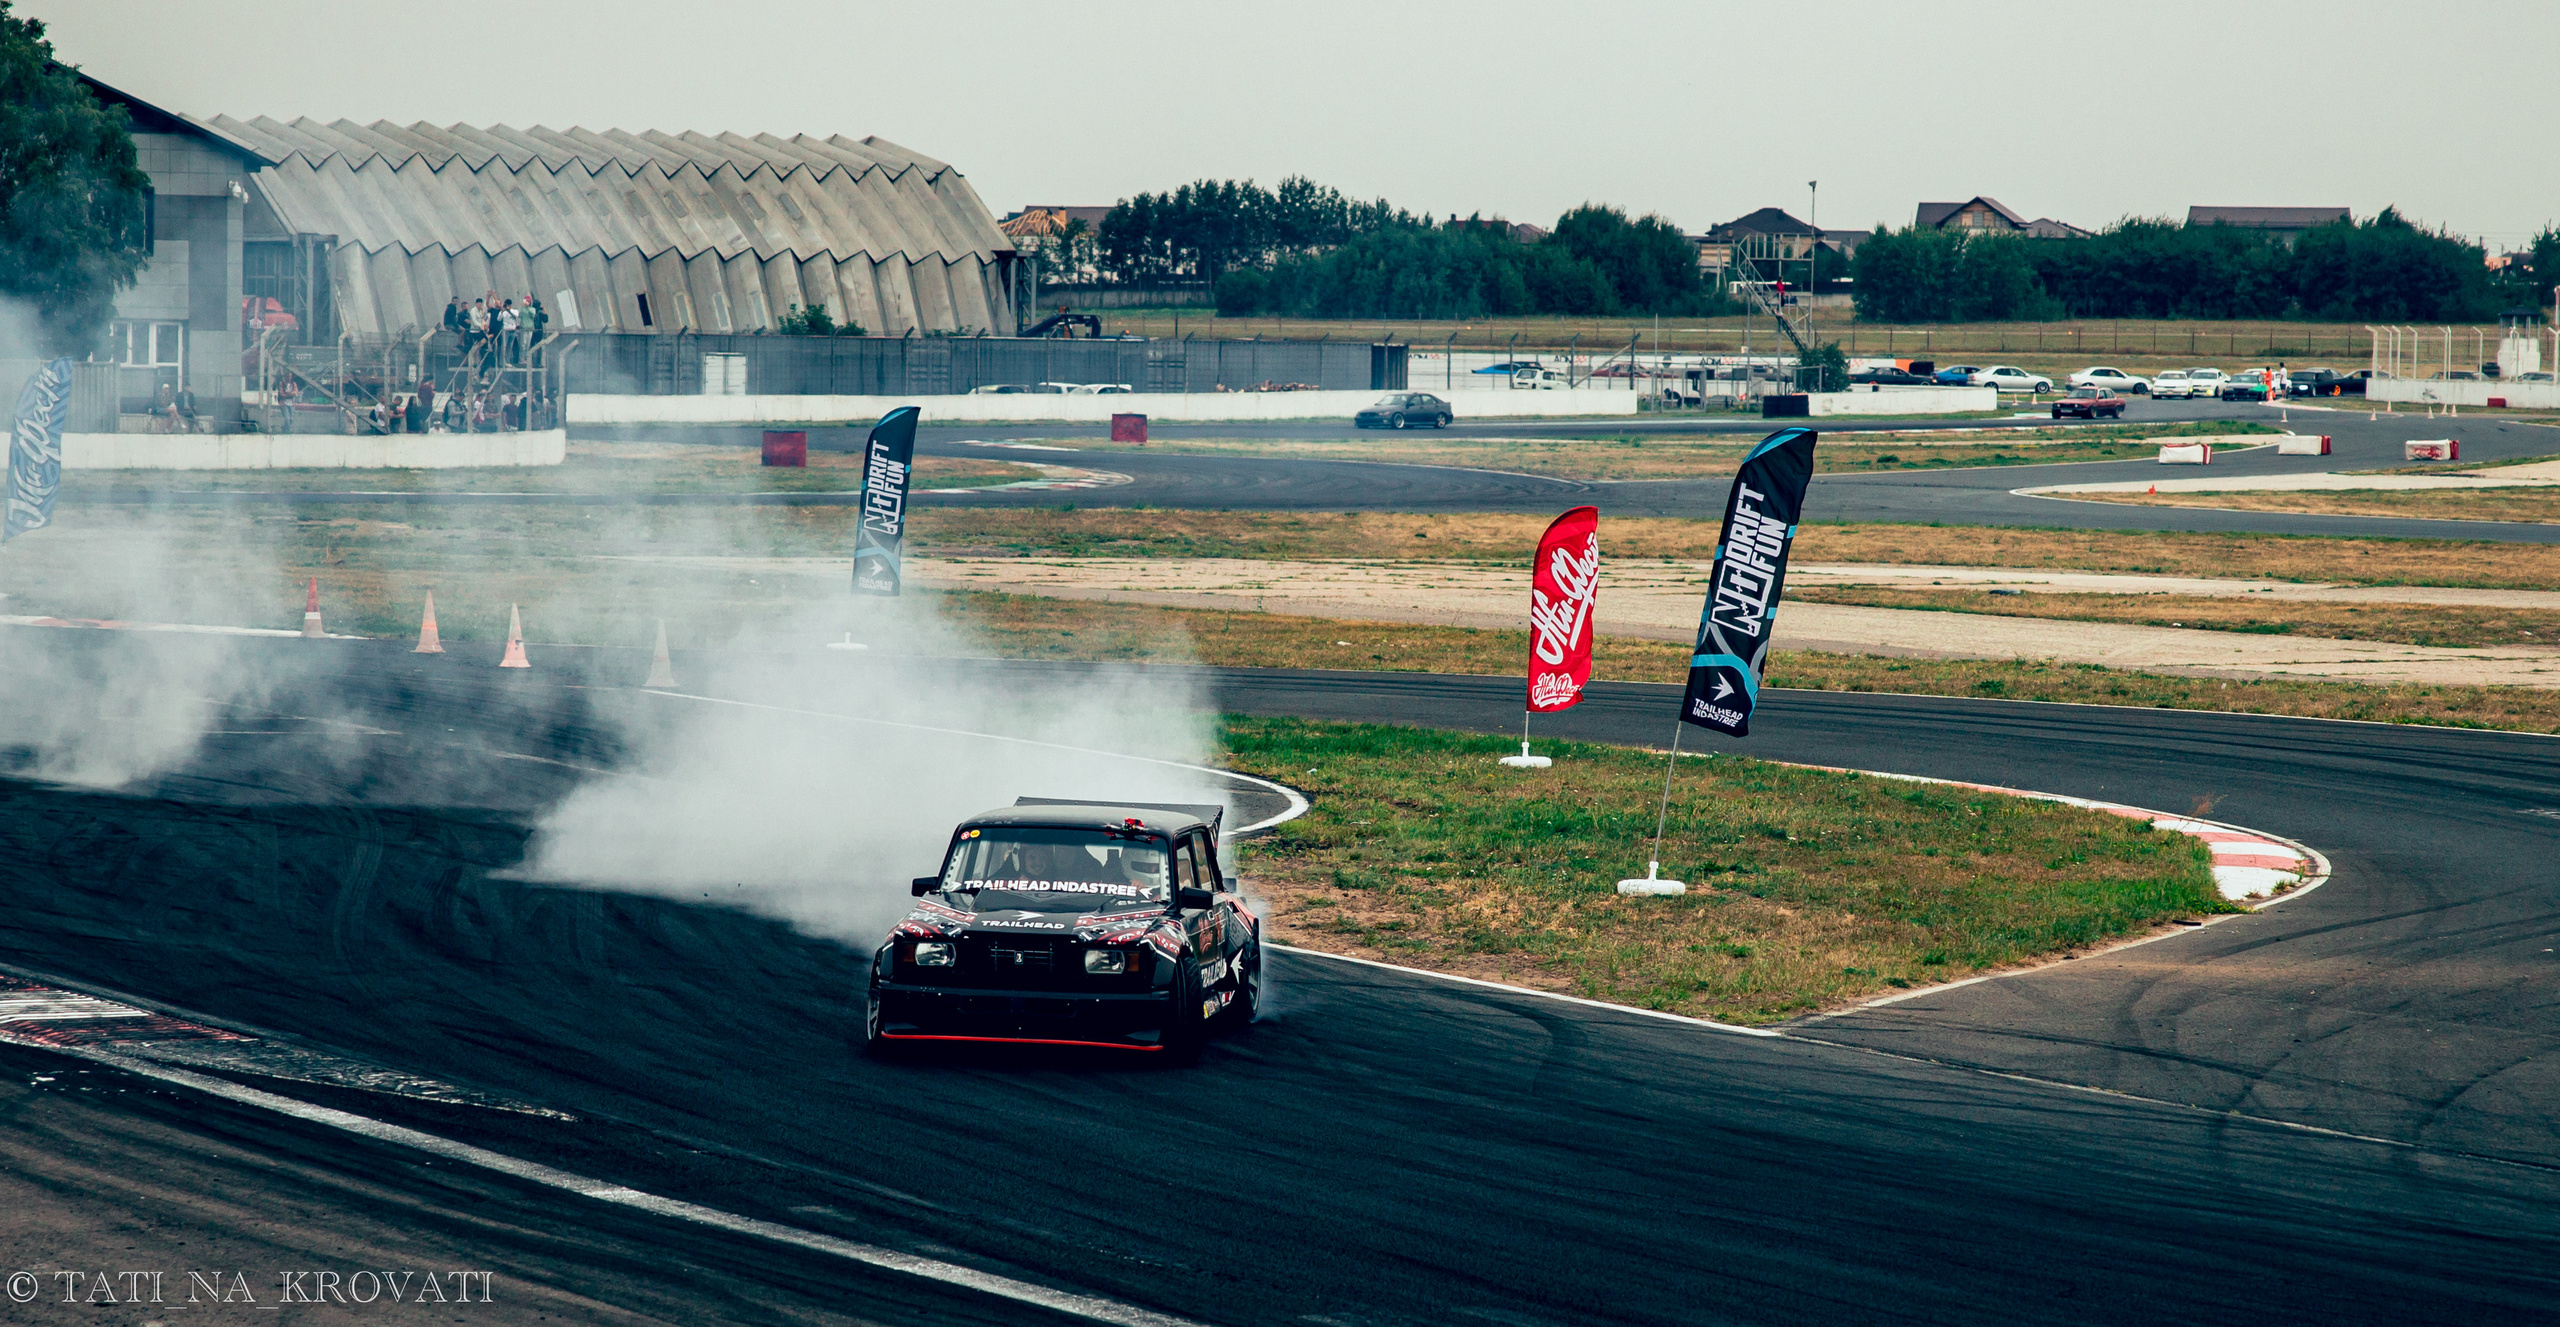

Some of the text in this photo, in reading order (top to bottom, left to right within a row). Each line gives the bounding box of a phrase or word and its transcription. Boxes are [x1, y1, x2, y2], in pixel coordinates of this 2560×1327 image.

[868, 440, 890, 490] DRIFT
[884, 460, 905, 494] FUN
[1725, 482, 1765, 564] DRIFT
[1751, 515, 1787, 574] FUN
[1692, 706, 1739, 728] INDASTREE
[1695, 698, 1744, 721] TRAILHEAD
[964, 879, 1138, 897] TRAILHEAD INDASTREE
[981, 920, 1066, 930] TRAILHEAD
